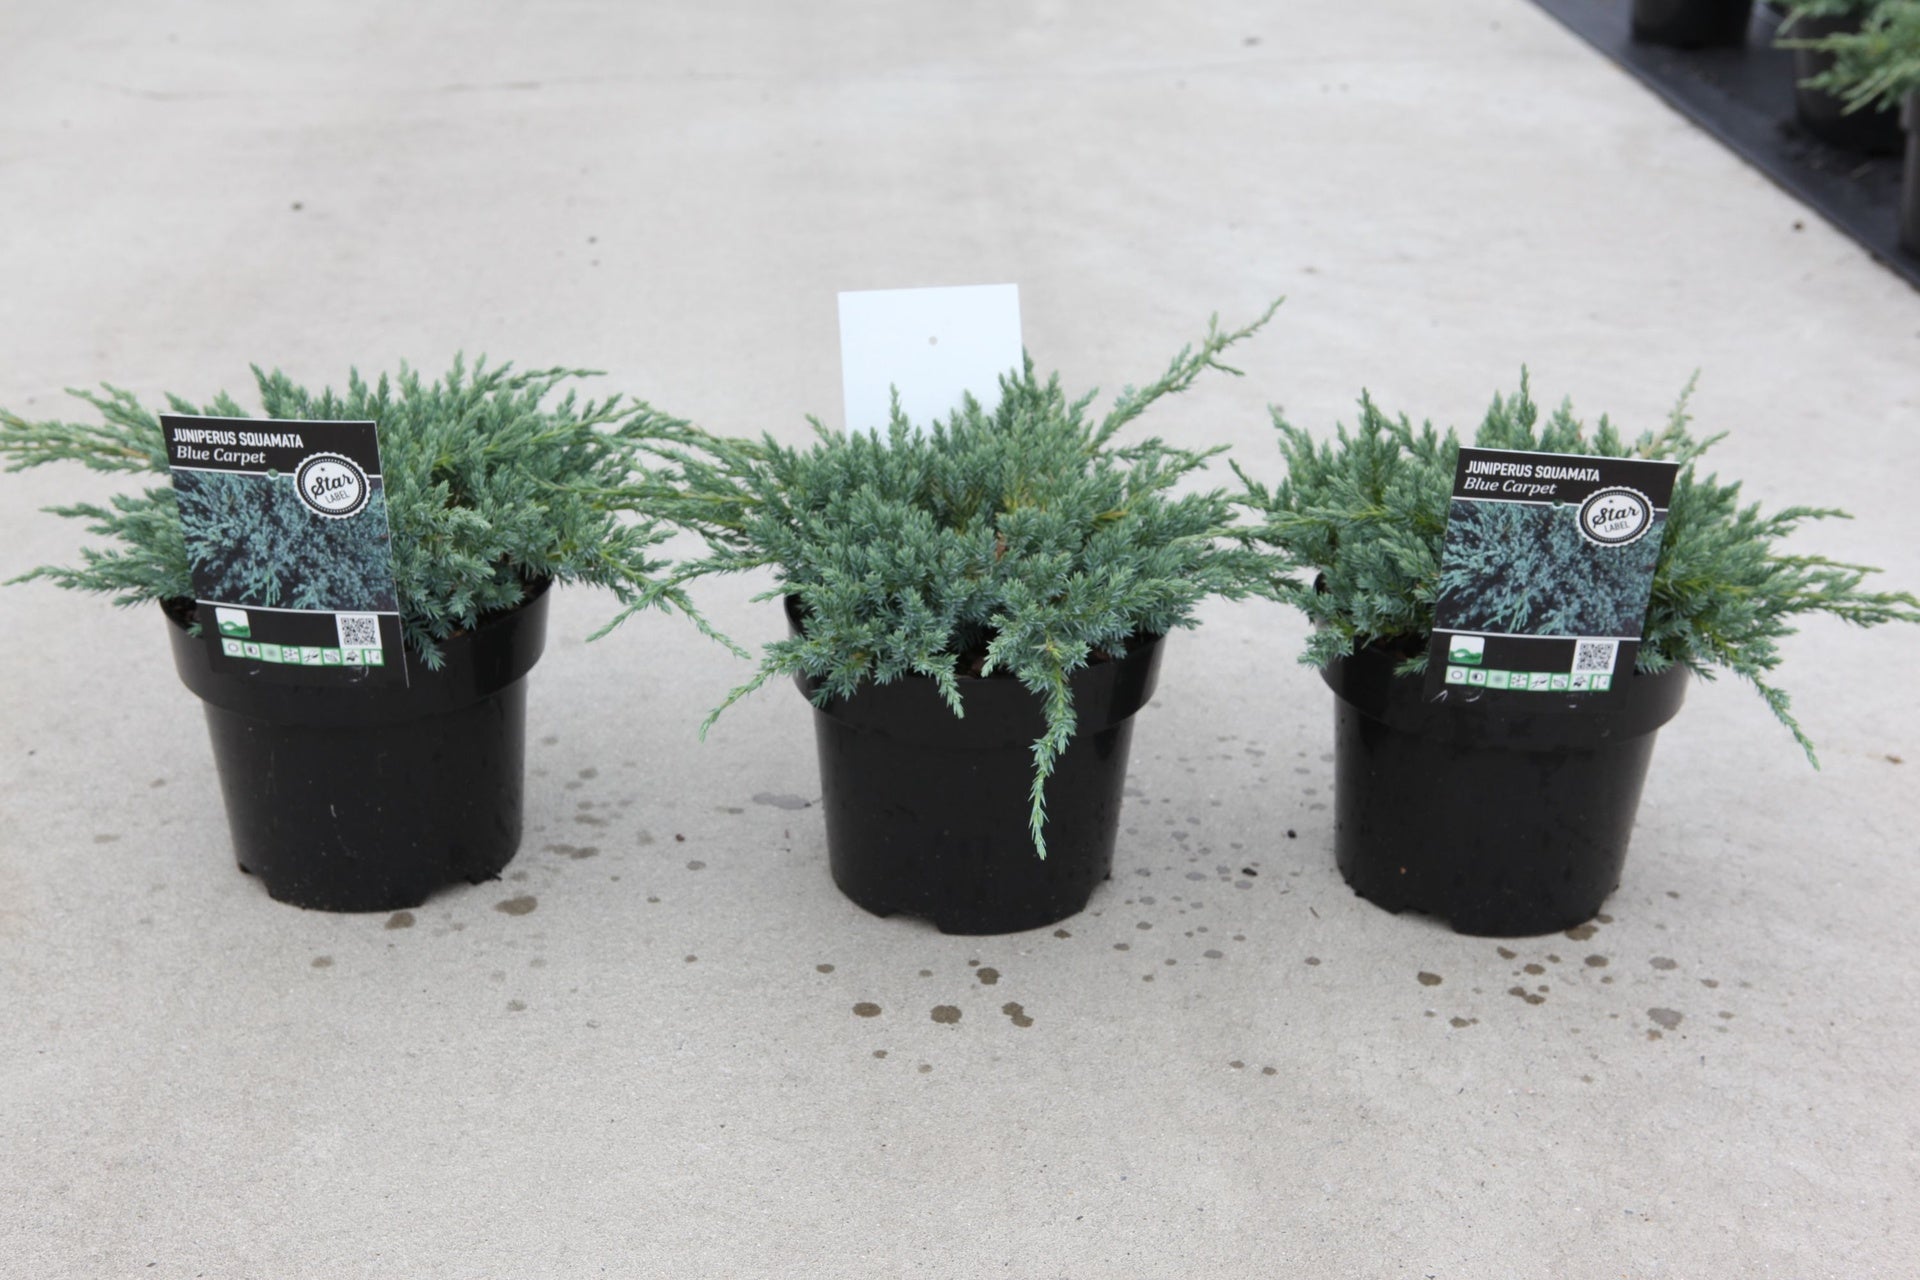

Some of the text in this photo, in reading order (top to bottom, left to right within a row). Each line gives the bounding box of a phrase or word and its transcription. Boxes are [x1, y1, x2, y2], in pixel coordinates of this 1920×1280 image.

[173, 428, 304, 448] JUNIPERUS SQUAMATA
[176, 445, 266, 466] Blue Carpet
[1465, 460, 1600, 481] JUNIPERUS SQUAMATA
[311, 473, 354, 500] Star
[325, 489, 350, 504] LABEL
[1464, 477, 1557, 496] Blue Carpet
[1592, 506, 1640, 529] Star
[1604, 520, 1630, 533] LABEL
